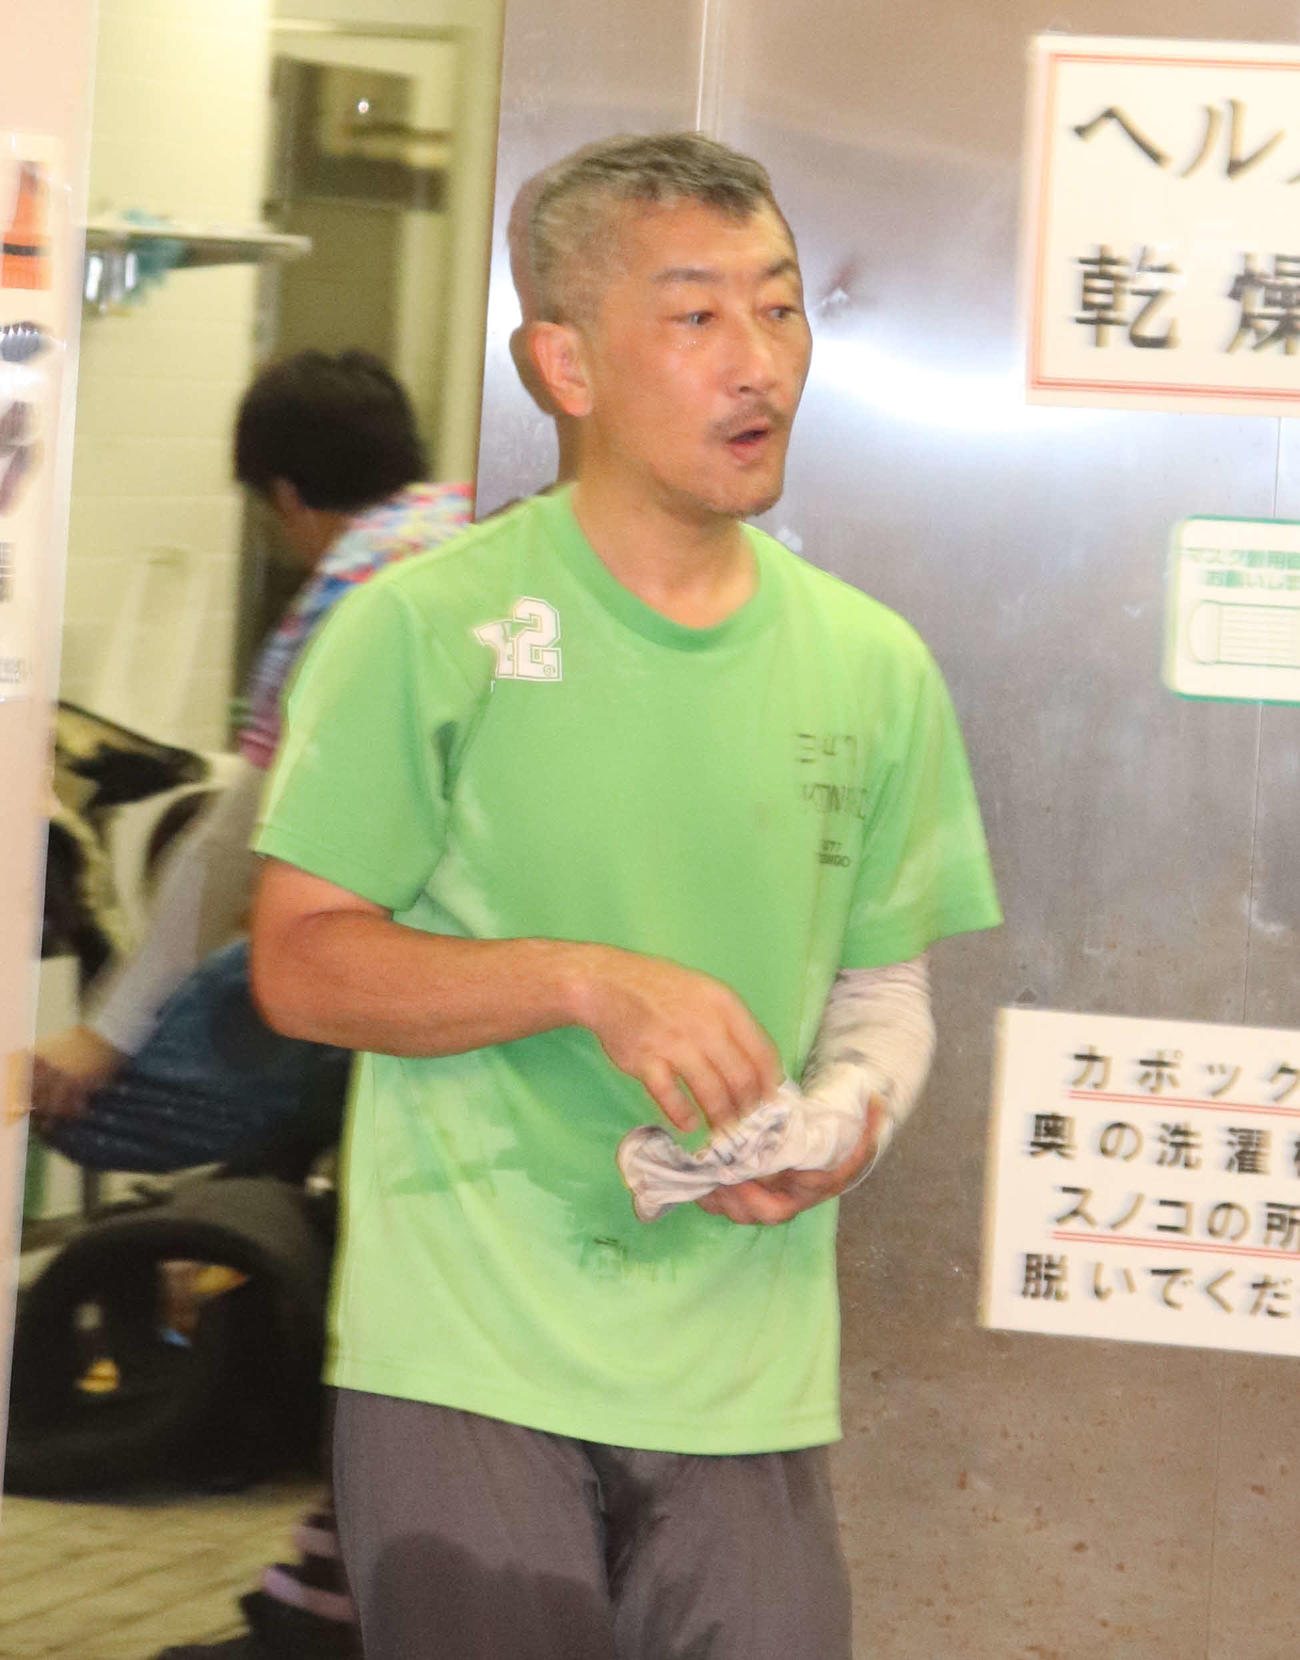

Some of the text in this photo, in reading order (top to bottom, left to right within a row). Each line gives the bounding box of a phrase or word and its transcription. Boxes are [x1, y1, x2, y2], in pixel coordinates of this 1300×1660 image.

[1073, 98, 1300, 184] ヘル
[1073, 244, 1300, 355] 乾燥
[1029, 1113, 1300, 1178] 奥の洗濯
[1054, 1185, 1300, 1250] スノコの所
[1021, 1252, 1293, 1319] 脱いでくだ
